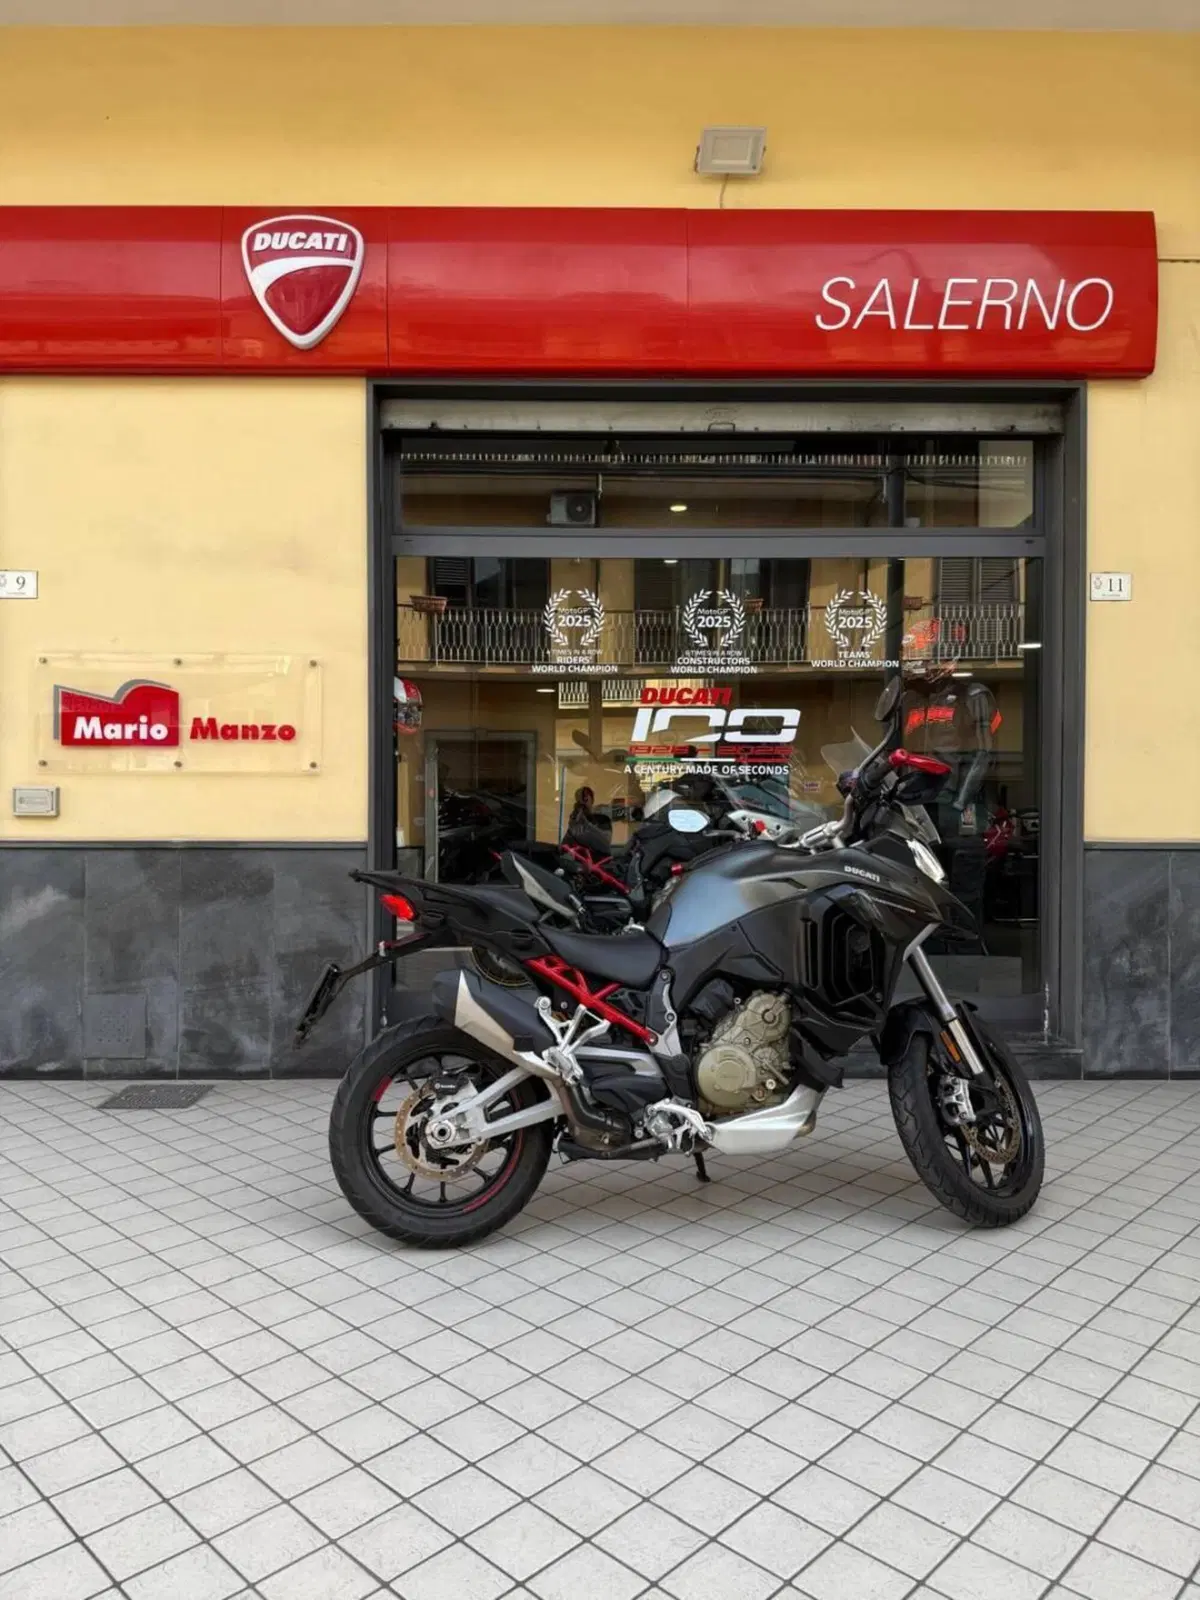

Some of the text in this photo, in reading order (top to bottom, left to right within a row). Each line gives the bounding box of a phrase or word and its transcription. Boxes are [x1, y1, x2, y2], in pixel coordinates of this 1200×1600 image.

[253, 232, 348, 251] DUCATI
[815, 276, 1114, 331] SALERNO
[16, 576, 26, 590] 9
[1109, 578, 1122, 592] 11
[558, 615, 592, 627] 2025
[697, 616, 731, 628] 2025
[838, 616, 873, 628] 2025
[677, 657, 751, 665] CONSTRUCTORS
[811, 660, 900, 668] WORLD CHAMPION
[532, 665, 618, 673] WORLD CHAMPION
[670, 666, 758, 674] WORLD CHAMPION
[640, 687, 733, 705] DUCATI
[73, 715, 297, 742] Mario Manzo
[624, 765, 789, 775] A CENTURY MADE OF SECONDS
[844, 865, 880, 882] DUCATI
